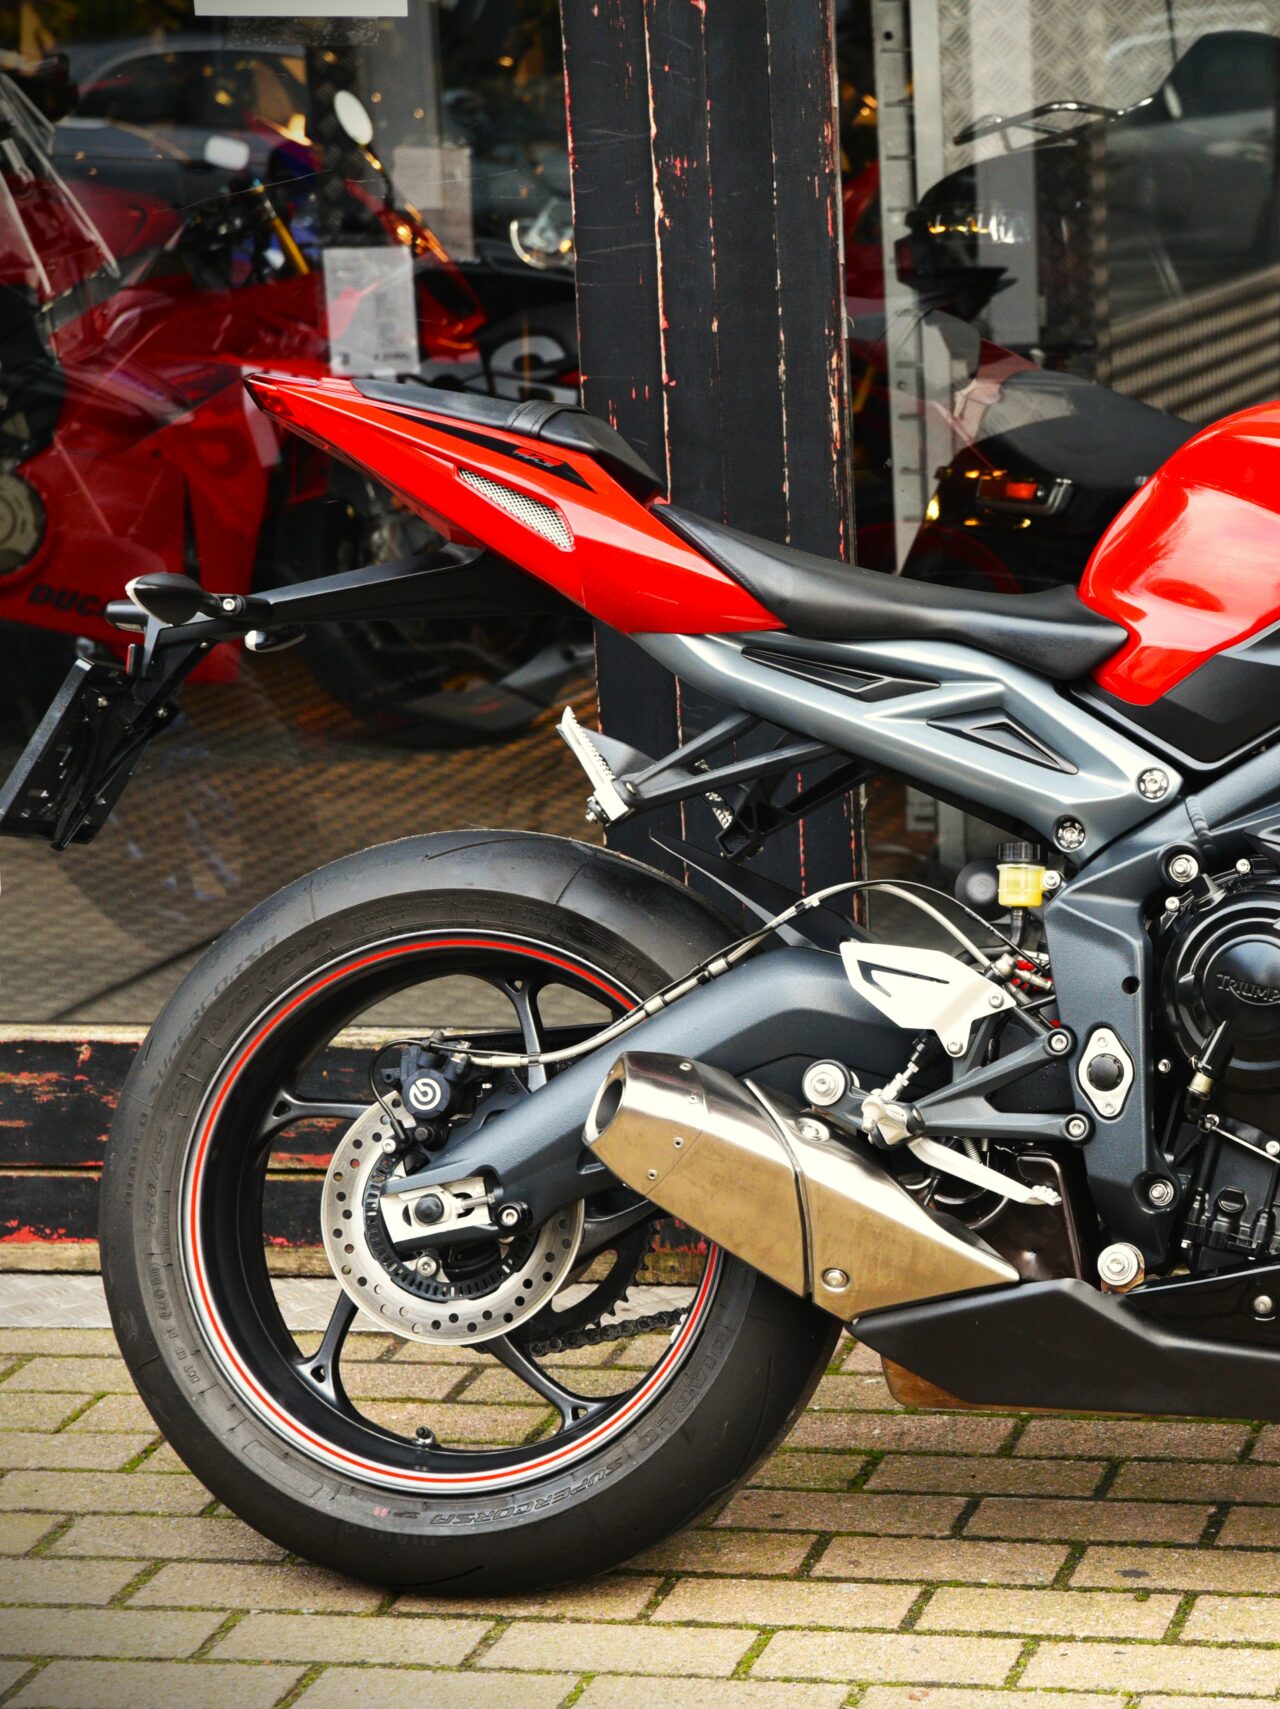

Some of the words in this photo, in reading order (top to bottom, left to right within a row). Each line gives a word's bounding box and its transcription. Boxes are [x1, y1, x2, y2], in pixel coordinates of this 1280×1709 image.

[29, 583, 106, 618] DUC
[635, 1330, 729, 1452] DIABLO
[429, 1456, 625, 1524] SUPERCORSA
